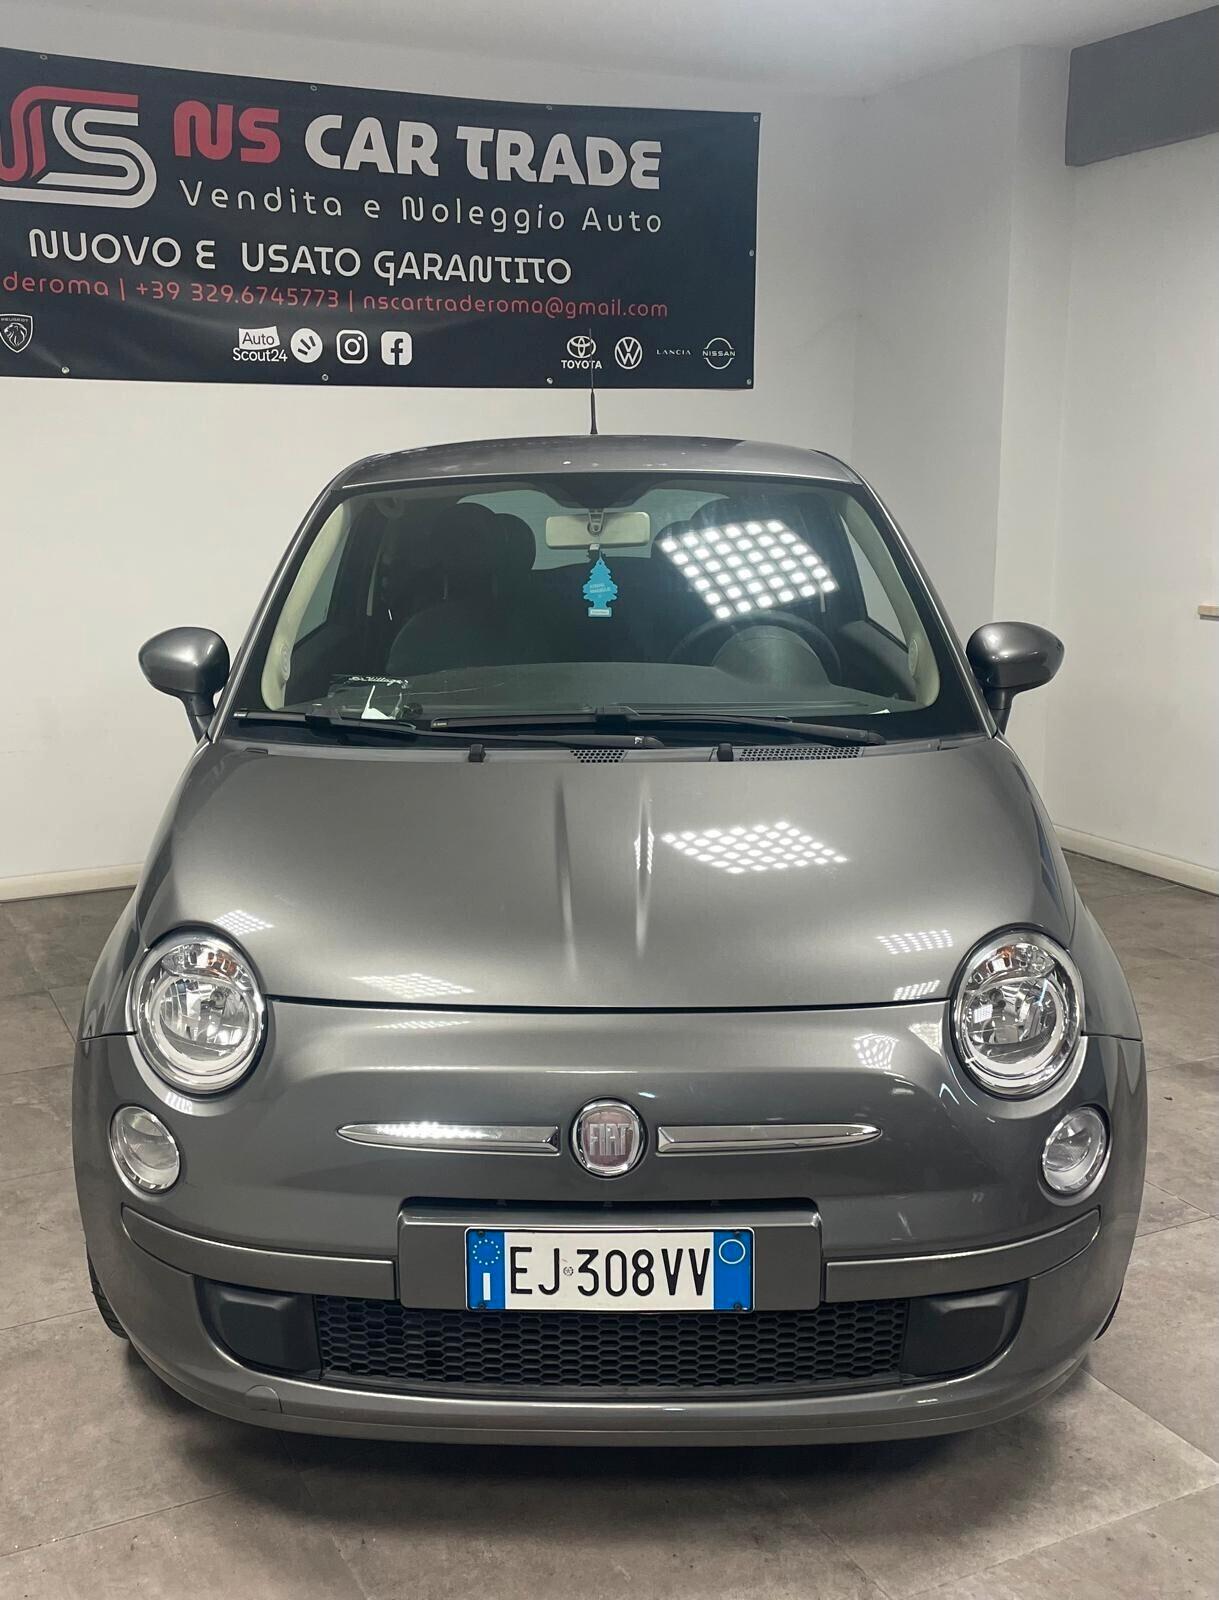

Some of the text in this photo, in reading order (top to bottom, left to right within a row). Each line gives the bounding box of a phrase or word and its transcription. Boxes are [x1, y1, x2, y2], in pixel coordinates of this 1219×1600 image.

[173, 100, 663, 190] NS CAR TRADE
[179, 179, 662, 234] Vendita e Noleggio Auto
[28, 228, 572, 287] NUOVO E USATO GARANTITO
[136, 280, 181, 300] +39
[191, 283, 339, 308] 329.6745773
[363, 294, 669, 320] nscartraderoma@gmail.com
[232, 348, 288, 363] Scout24
[241, 331, 276, 348] Auto
[560, 359, 603, 370] TOYOTA
[589, 1123, 630, 1156] FIAT
